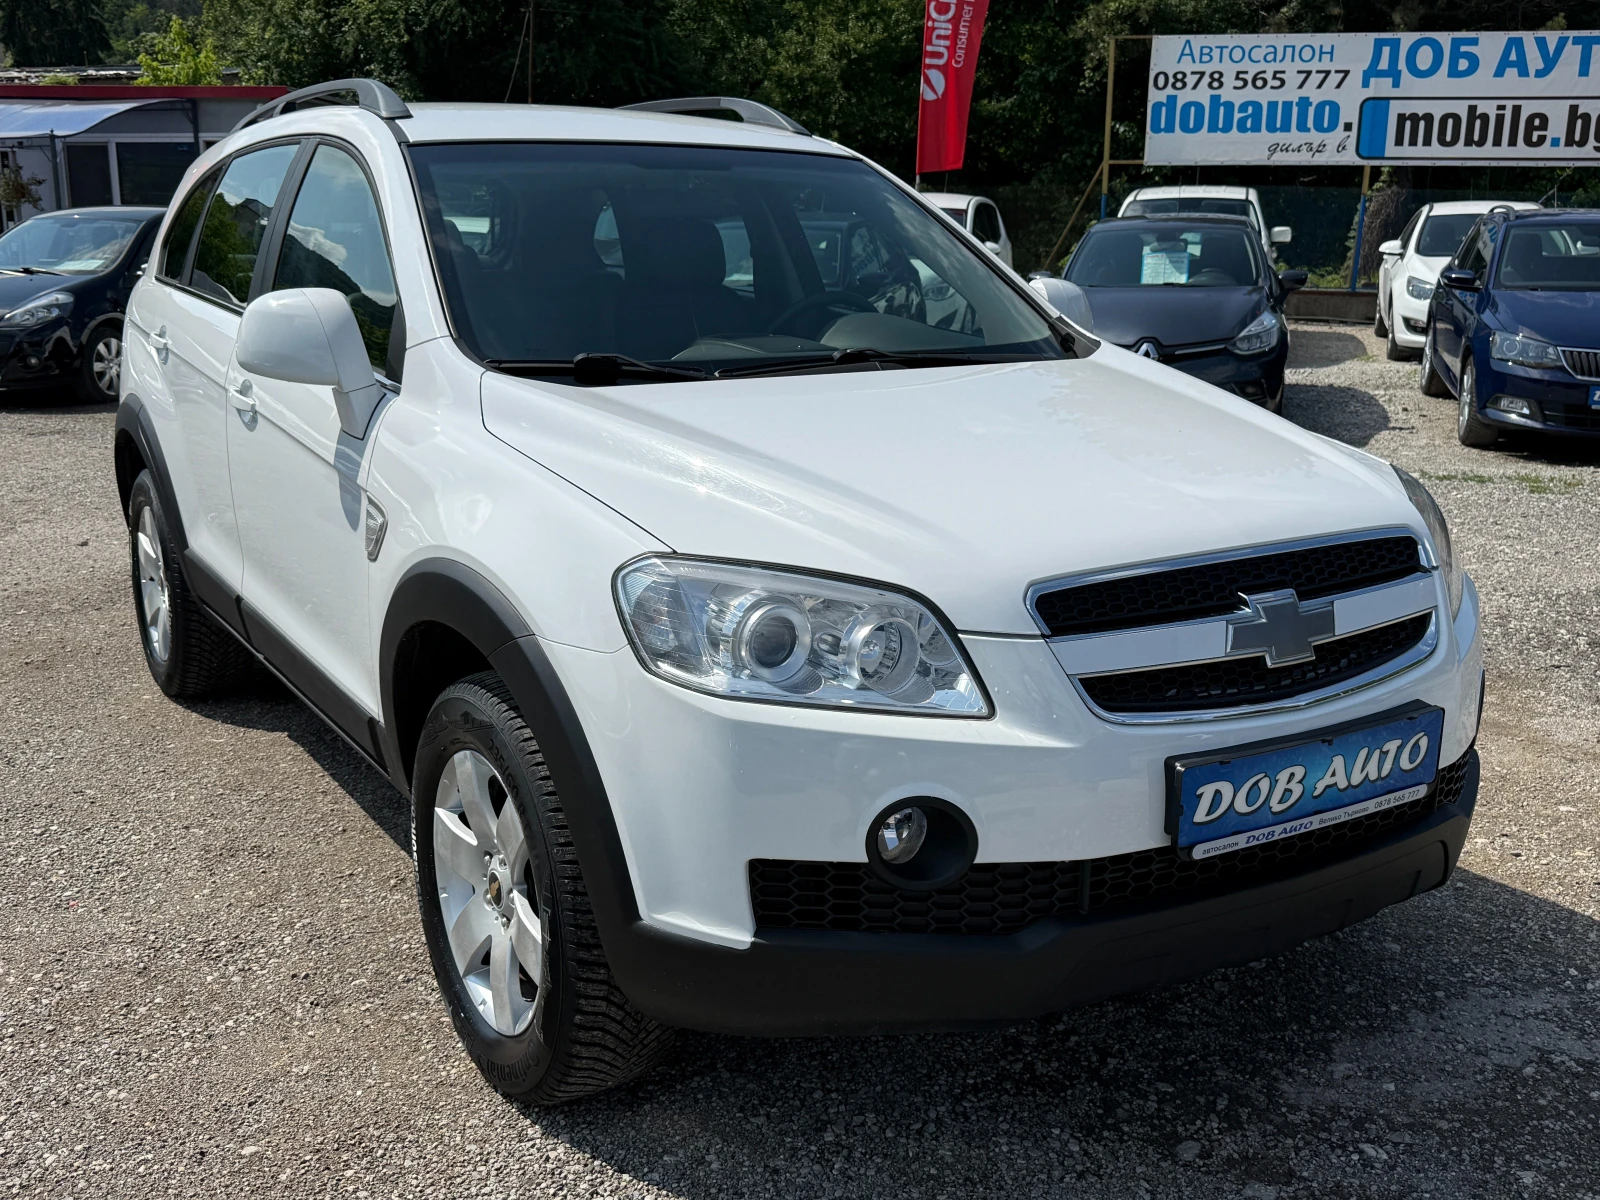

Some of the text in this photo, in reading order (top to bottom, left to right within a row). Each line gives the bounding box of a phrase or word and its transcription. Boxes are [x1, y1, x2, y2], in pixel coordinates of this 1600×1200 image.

[925, 0, 957, 65] UniC
[952, 4, 974, 68] Consumer
[1176, 39, 1335, 64] Автосалон
[1153, 69, 1351, 91] 0878 565 777
[1361, 36, 1481, 88] ДОБ
[1150, 94, 1353, 134] dobauto.
[1394, 104, 1600, 153] mobile.b
[1267, 134, 1351, 160] дилър в
[1192, 731, 1430, 825] DOB AUTO
[1202, 789, 1420, 855] автосалон DOB AUTO Велико Търново 0878 565 777
